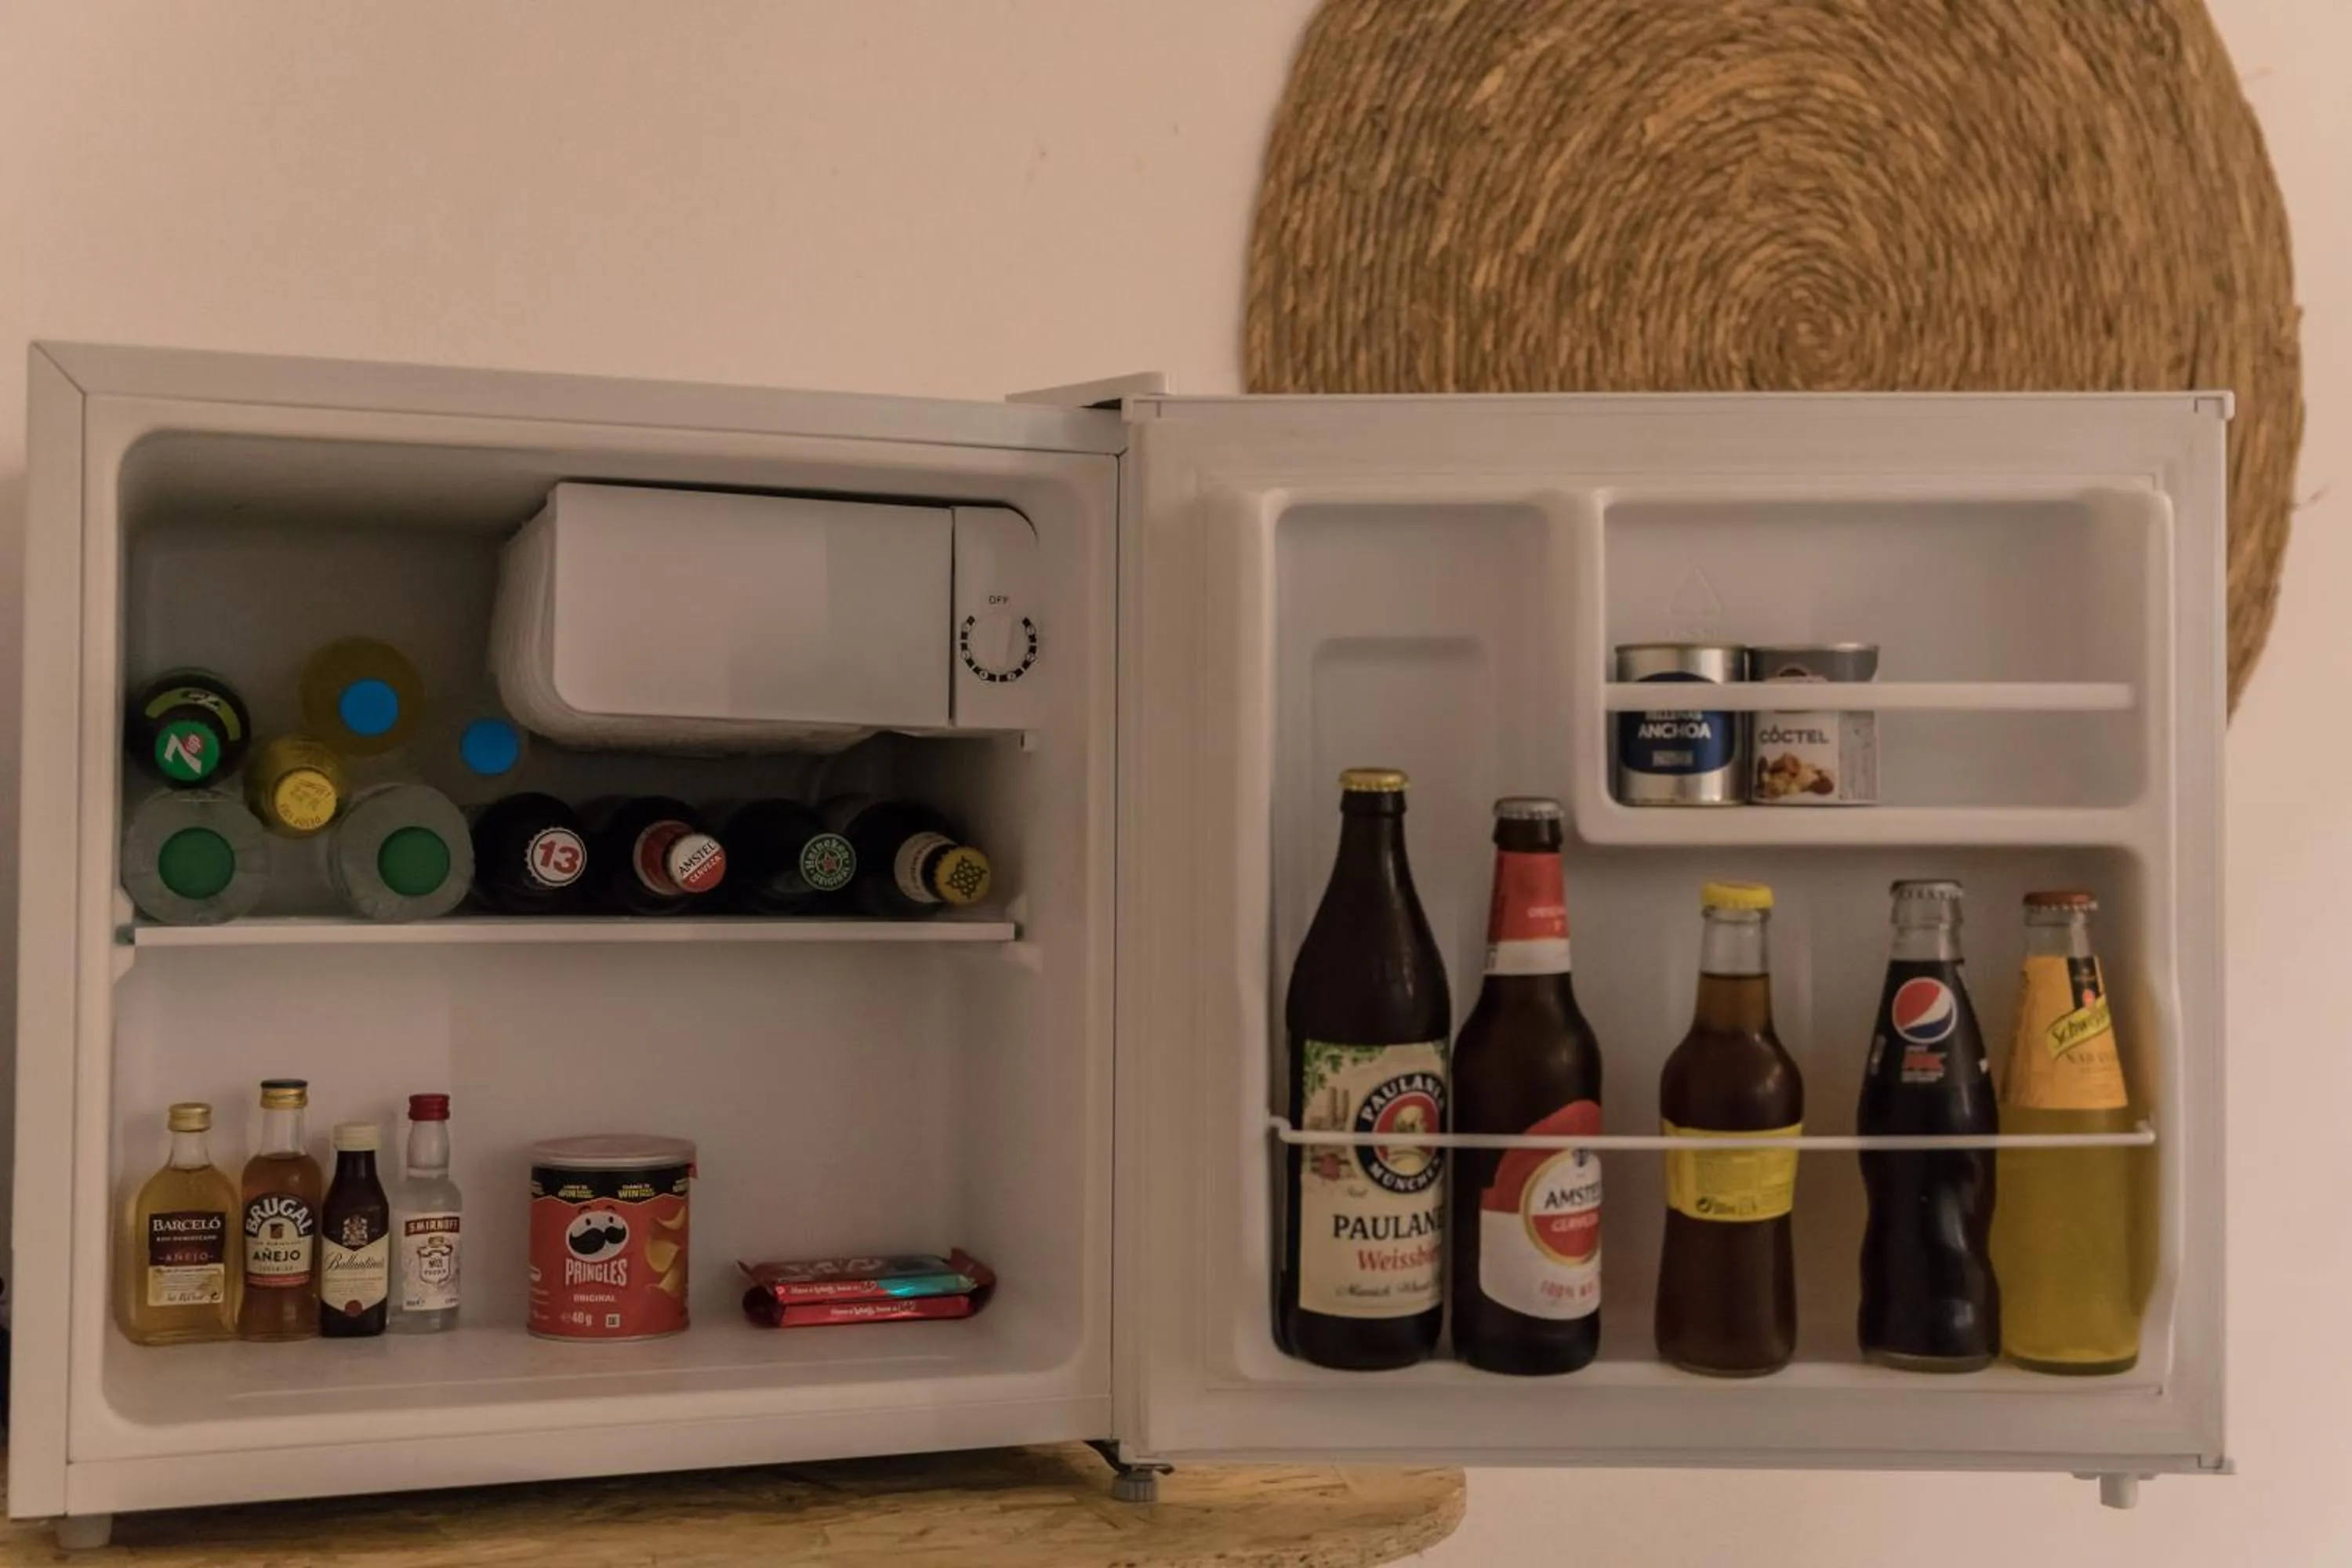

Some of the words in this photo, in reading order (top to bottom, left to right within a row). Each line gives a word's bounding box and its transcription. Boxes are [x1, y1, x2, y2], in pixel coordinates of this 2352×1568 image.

[989, 595, 1009, 604] OFF
[1637, 722, 1711, 739] ANCHOA
[1759, 724, 1830, 744] CÓCTEL
[539, 840, 579, 874] 13
[679, 843, 716, 875] AMSTEL
[153, 1216, 221, 1232] BARCELÓ
[245, 1197, 314, 1235] BRUGAL
[252, 1247, 301, 1262] AÑEJO
[565, 1258, 627, 1287] PRINGLES
